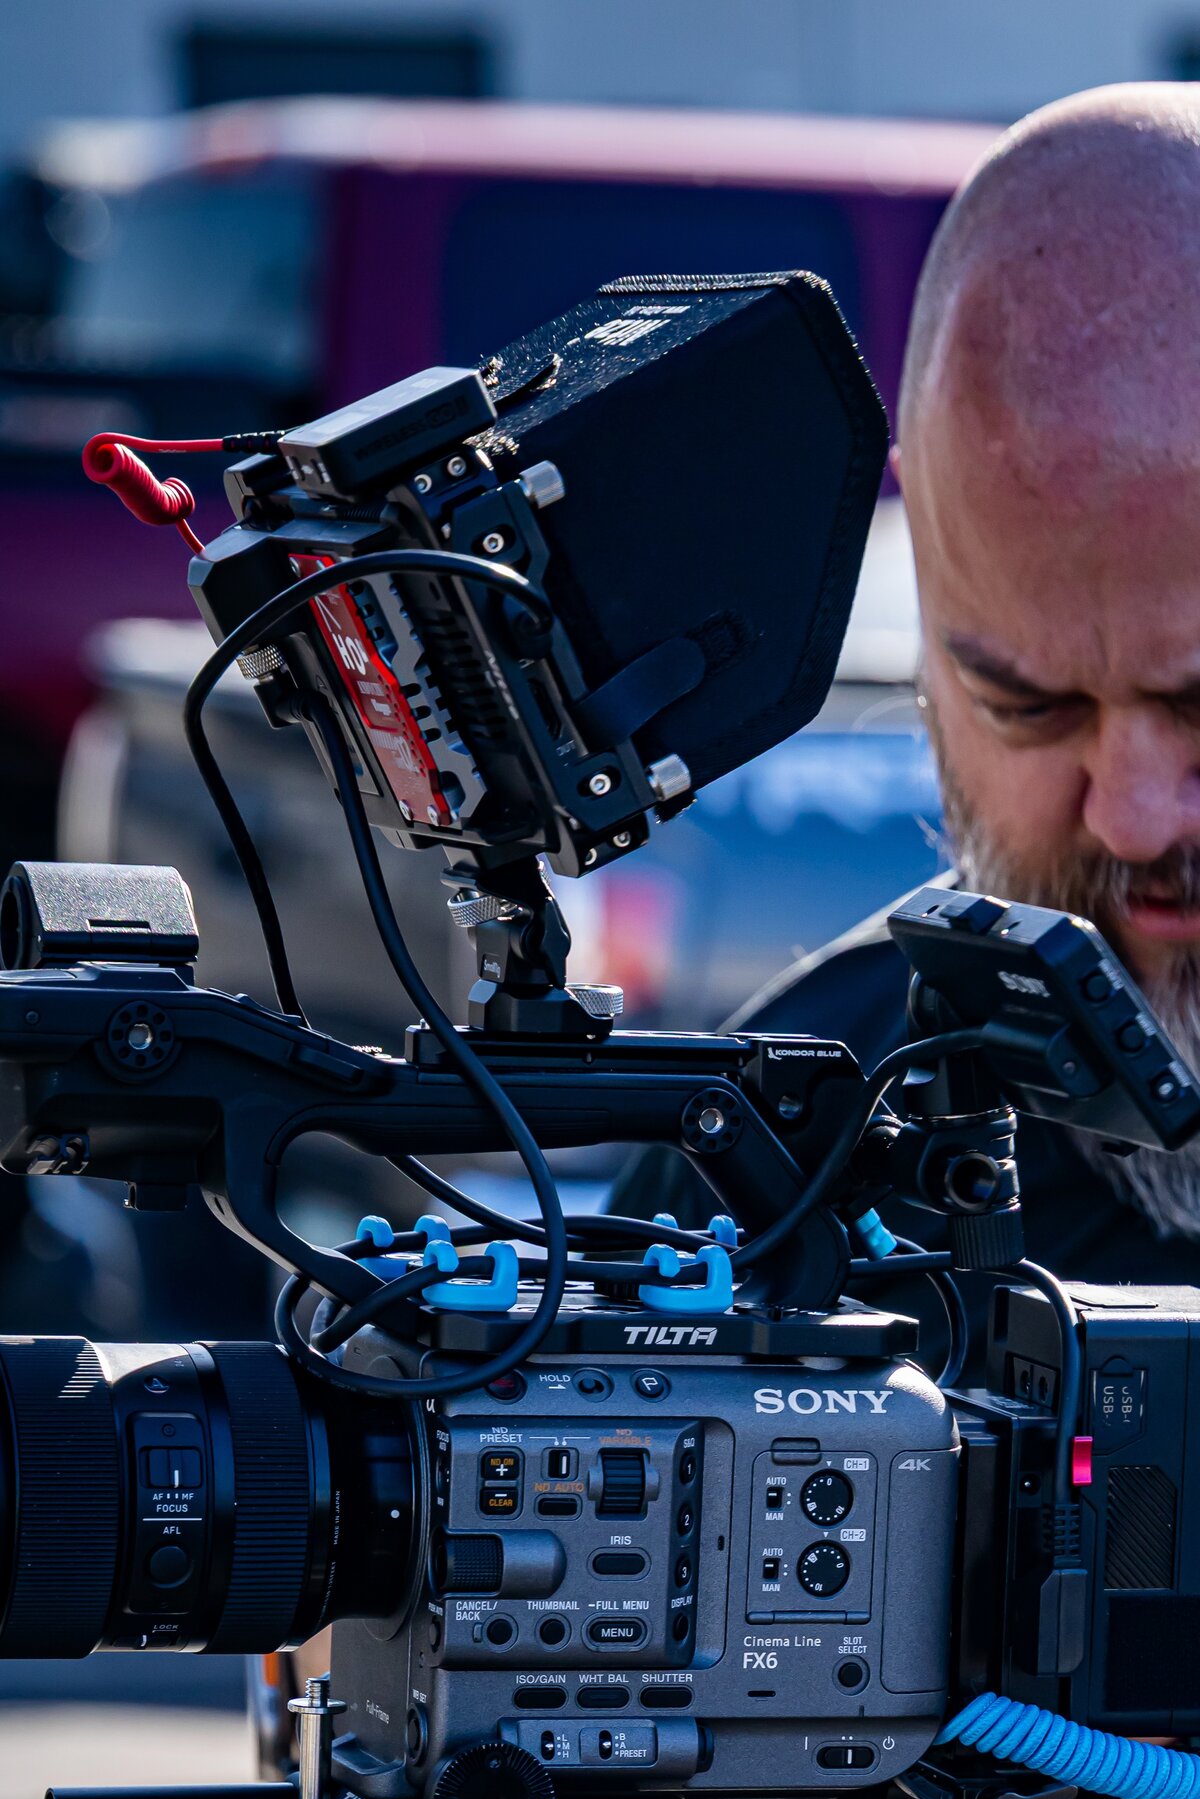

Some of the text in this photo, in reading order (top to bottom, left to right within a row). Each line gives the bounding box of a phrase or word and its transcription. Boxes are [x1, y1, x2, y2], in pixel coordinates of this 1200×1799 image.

[775, 1049, 842, 1058] KONDOR BLUE
[624, 1326, 718, 1345] TILTA
[539, 1374, 571, 1383] HOLD
[753, 1388, 894, 1414] SONY
[491, 1426, 509, 1434] ND
[479, 1433, 523, 1443] PRESET
[490, 1458, 514, 1466] ND ON
[846, 1459, 868, 1469] CH-1
[898, 1458, 932, 1471] 4K
[766, 1476, 787, 1486] AUTO
[826, 1477, 833, 1486] 0
[534, 1482, 585, 1493] ND AUTO
[152, 1493, 195, 1501] AF MF
[488, 1498, 513, 1507] CLEAR
[156, 1504, 189, 1513] FOCUS
[684, 1514, 690, 1526] 2
[765, 1512, 784, 1521] MAN
[162, 1526, 182, 1535] AFL
[842, 1530, 865, 1540] CH-2
[610, 1535, 632, 1545] IRIS
[762, 1547, 784, 1557] AUTO
[762, 1583, 781, 1592] MAN
[455, 1600, 498, 1611] CANCEL/
[527, 1600, 580, 1610] THUMBNAIL
[622, 1600, 650, 1610] MENU
[671, 1595, 693, 1609] DISPLAY
[455, 1611, 481, 1621] BACK
[601, 1627, 634, 1638] MENU
[743, 1636, 822, 1647] Cinema Line
[843, 1636, 863, 1646] SLOT
[838, 1645, 868, 1654] SELECT
[742, 1652, 778, 1669] FX6
[515, 1674, 566, 1684] ISO/GAIN
[579, 1673, 629, 1683] WHT BAL
[641, 1673, 693, 1682] SHUTTER
[562, 1734, 567, 1742] L
[619, 1733, 626, 1741] B
[562, 1742, 570, 1750] M
[619, 1741, 626, 1749] A
[562, 1750, 569, 1758] H
[619, 1749, 647, 1758] PRESET
